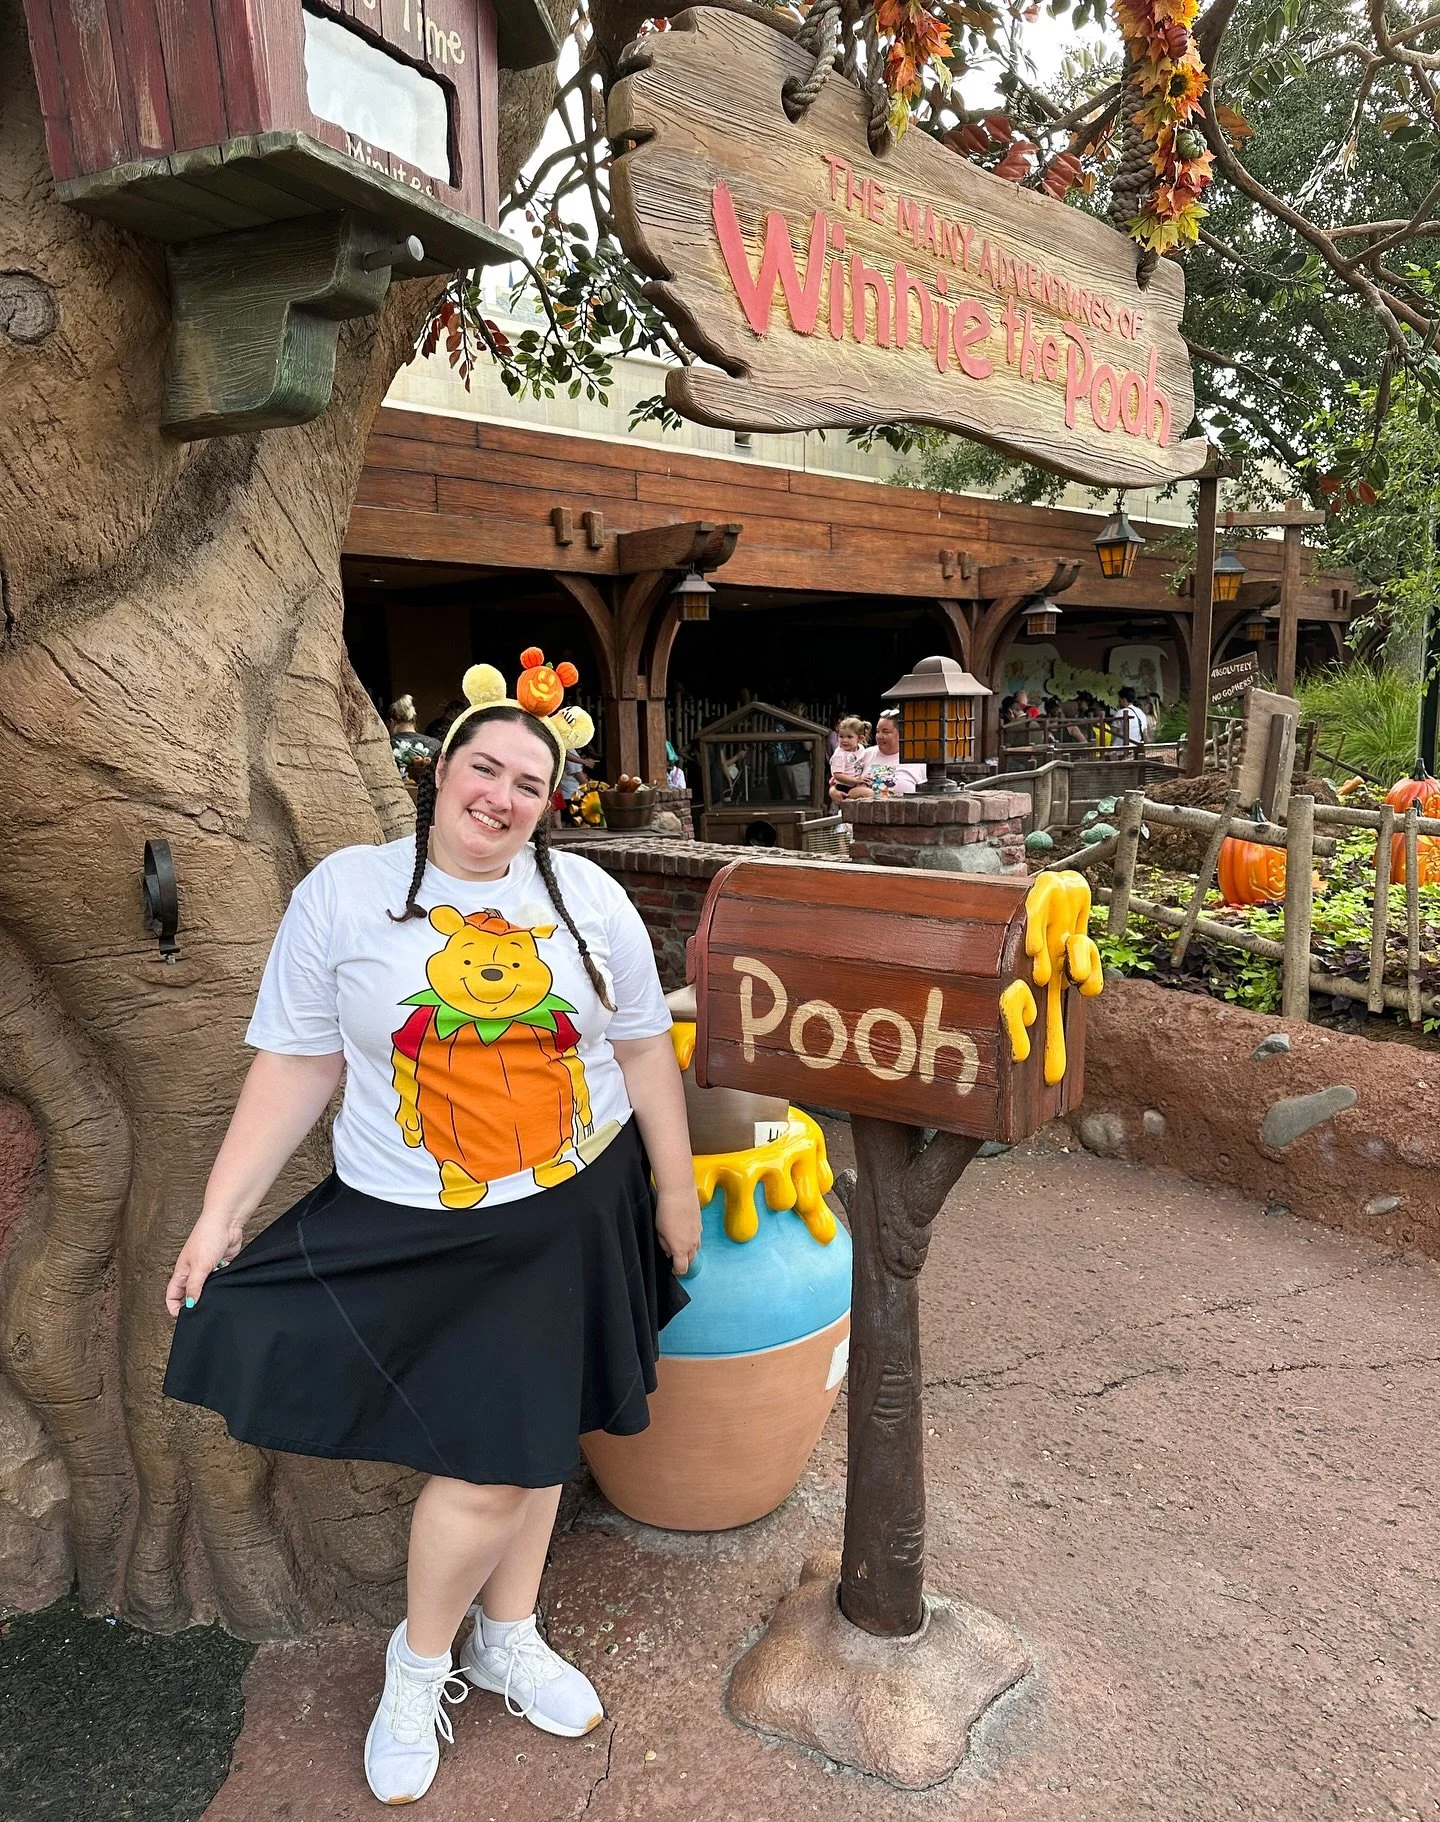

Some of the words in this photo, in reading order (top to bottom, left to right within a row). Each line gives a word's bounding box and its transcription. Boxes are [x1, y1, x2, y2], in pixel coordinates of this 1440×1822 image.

[712, 178, 993, 380] Winnie
[1002, 295, 1060, 383] the
[1062, 321, 1171, 448] Pooh
[823, 152, 886, 226] THE
[897, 193, 976, 271] MANY
[978, 239, 1115, 333] ADVENTURES
[1118, 307, 1144, 340] OF
[1210, 661, 1252, 679] ABSOLUTELY
[1212, 692, 1222, 703] NO
[1222, 674, 1254, 698] GOPHERS!
[733, 956, 980, 1096] Pooh
